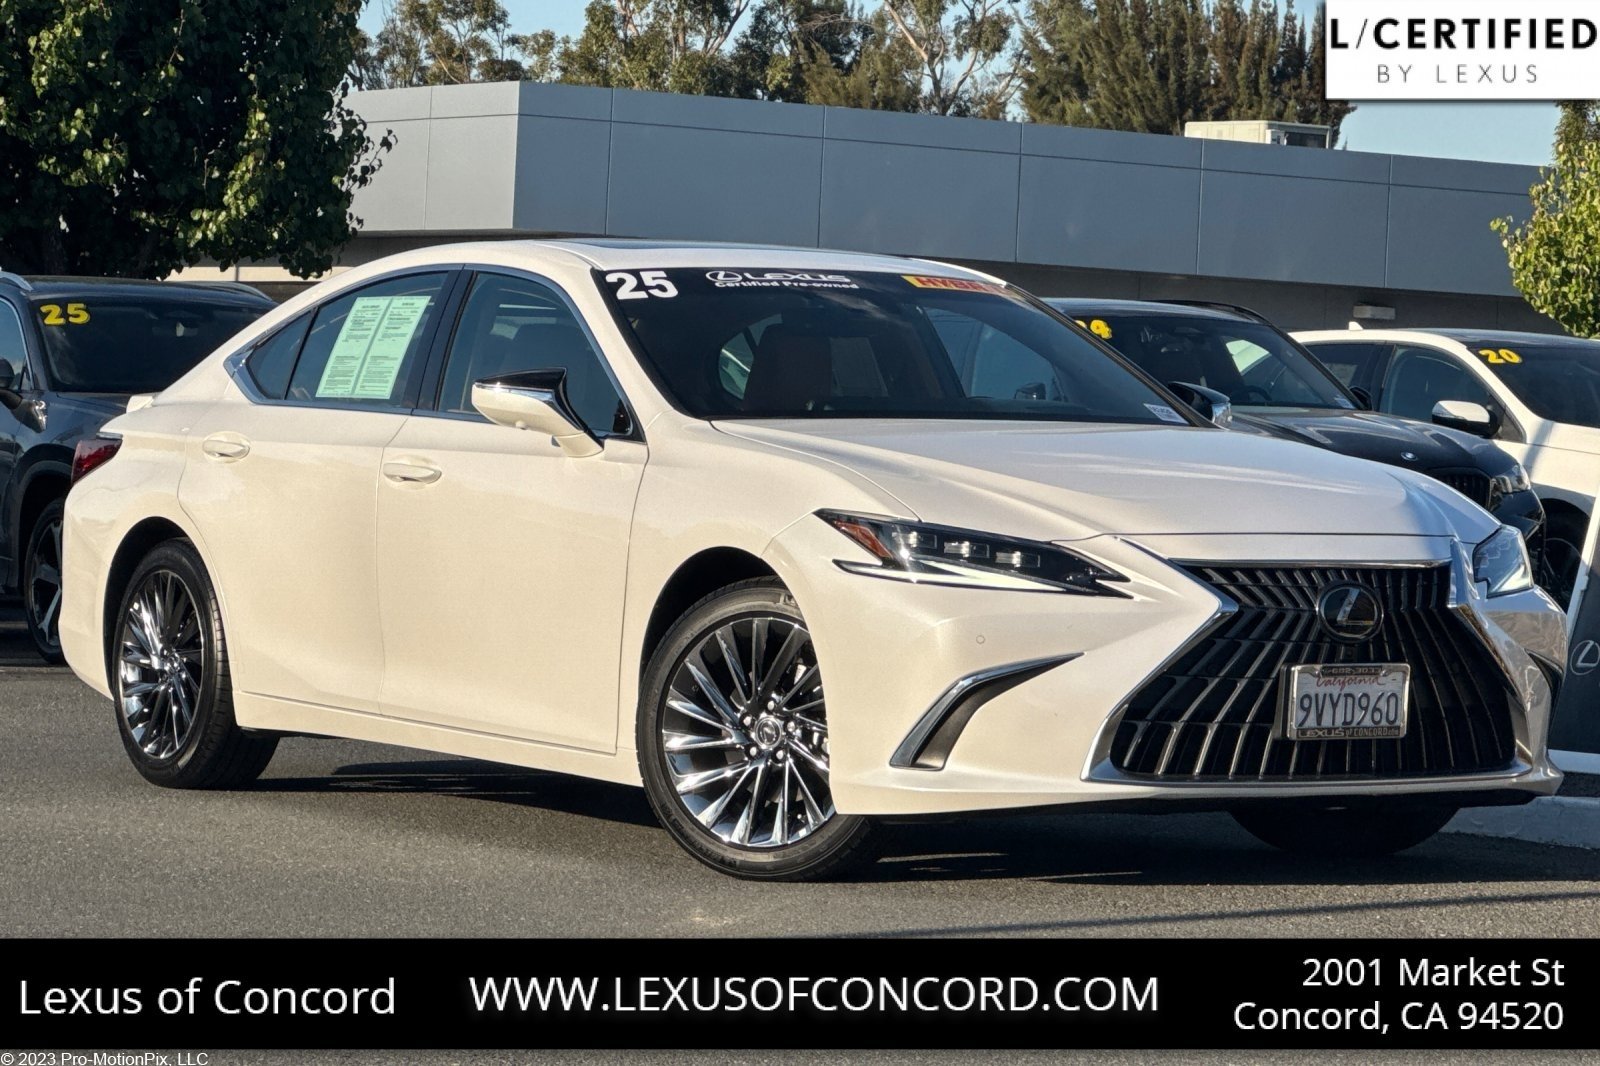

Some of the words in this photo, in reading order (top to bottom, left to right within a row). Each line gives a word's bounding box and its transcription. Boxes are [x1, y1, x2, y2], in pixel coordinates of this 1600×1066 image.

[605, 270, 679, 300] 25
[715, 279, 780, 288] Certified
[782, 280, 860, 289] Pre-owned
[743, 272, 852, 283] LEXUS
[40, 303, 90, 325] 25
[1478, 348, 1522, 364] 20
[1316, 675, 1386, 691] California
[1298, 692, 1398, 727] 9VYD960
[1298, 728, 1345, 738] LEXUS
